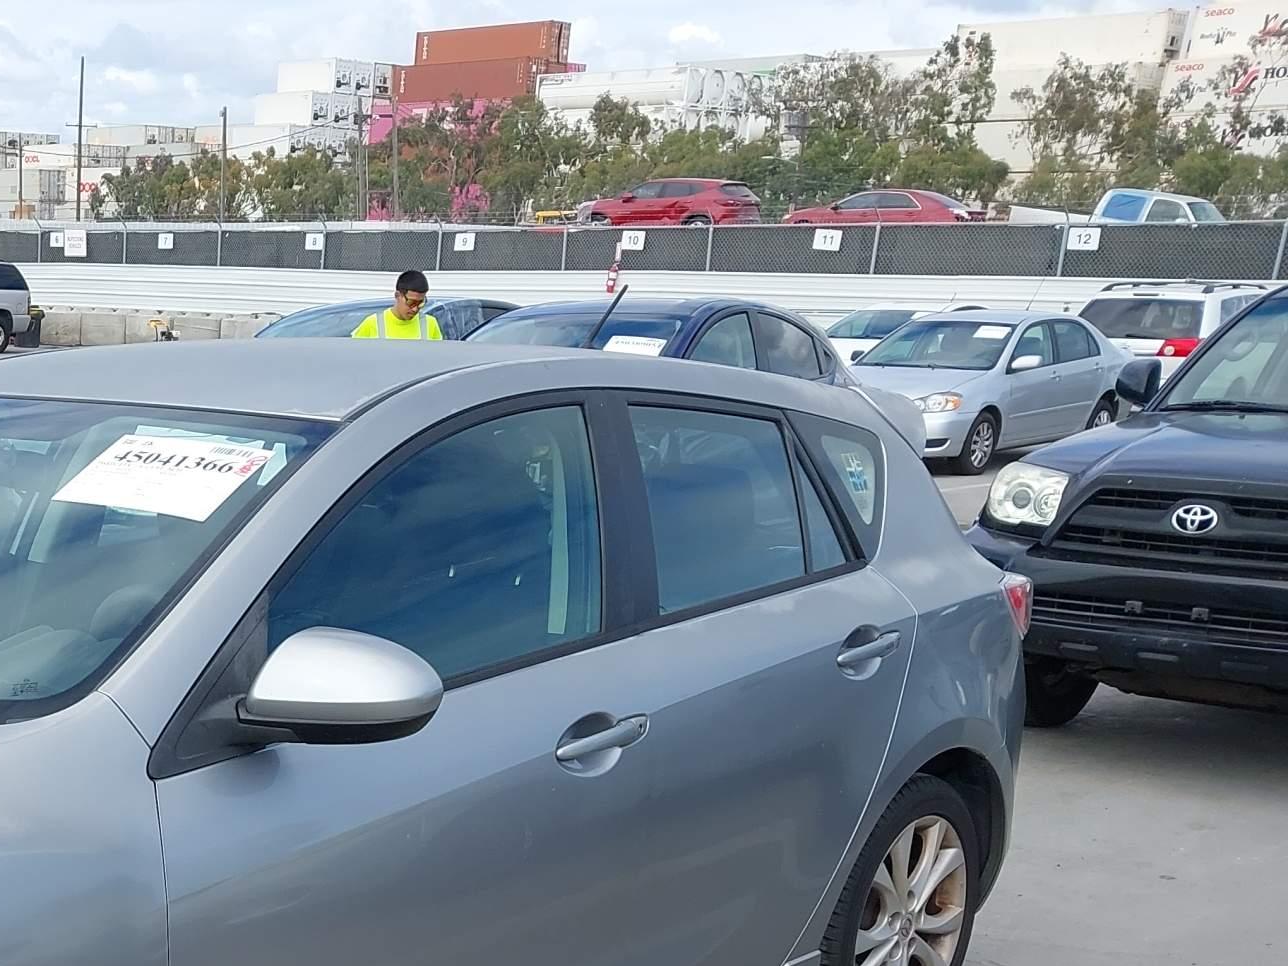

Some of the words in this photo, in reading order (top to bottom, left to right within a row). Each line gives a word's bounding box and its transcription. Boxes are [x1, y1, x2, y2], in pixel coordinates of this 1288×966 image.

[1205, 8, 1235, 17] seaco
[1174, 63, 1204, 72] seaco
[312, 237, 317, 245] 8
[462, 238, 467, 246] 9
[628, 235, 639, 245] 10
[823, 234, 833, 245] 11
[1077, 233, 1092, 244] 12
[114, 450, 240, 473] 45041366
